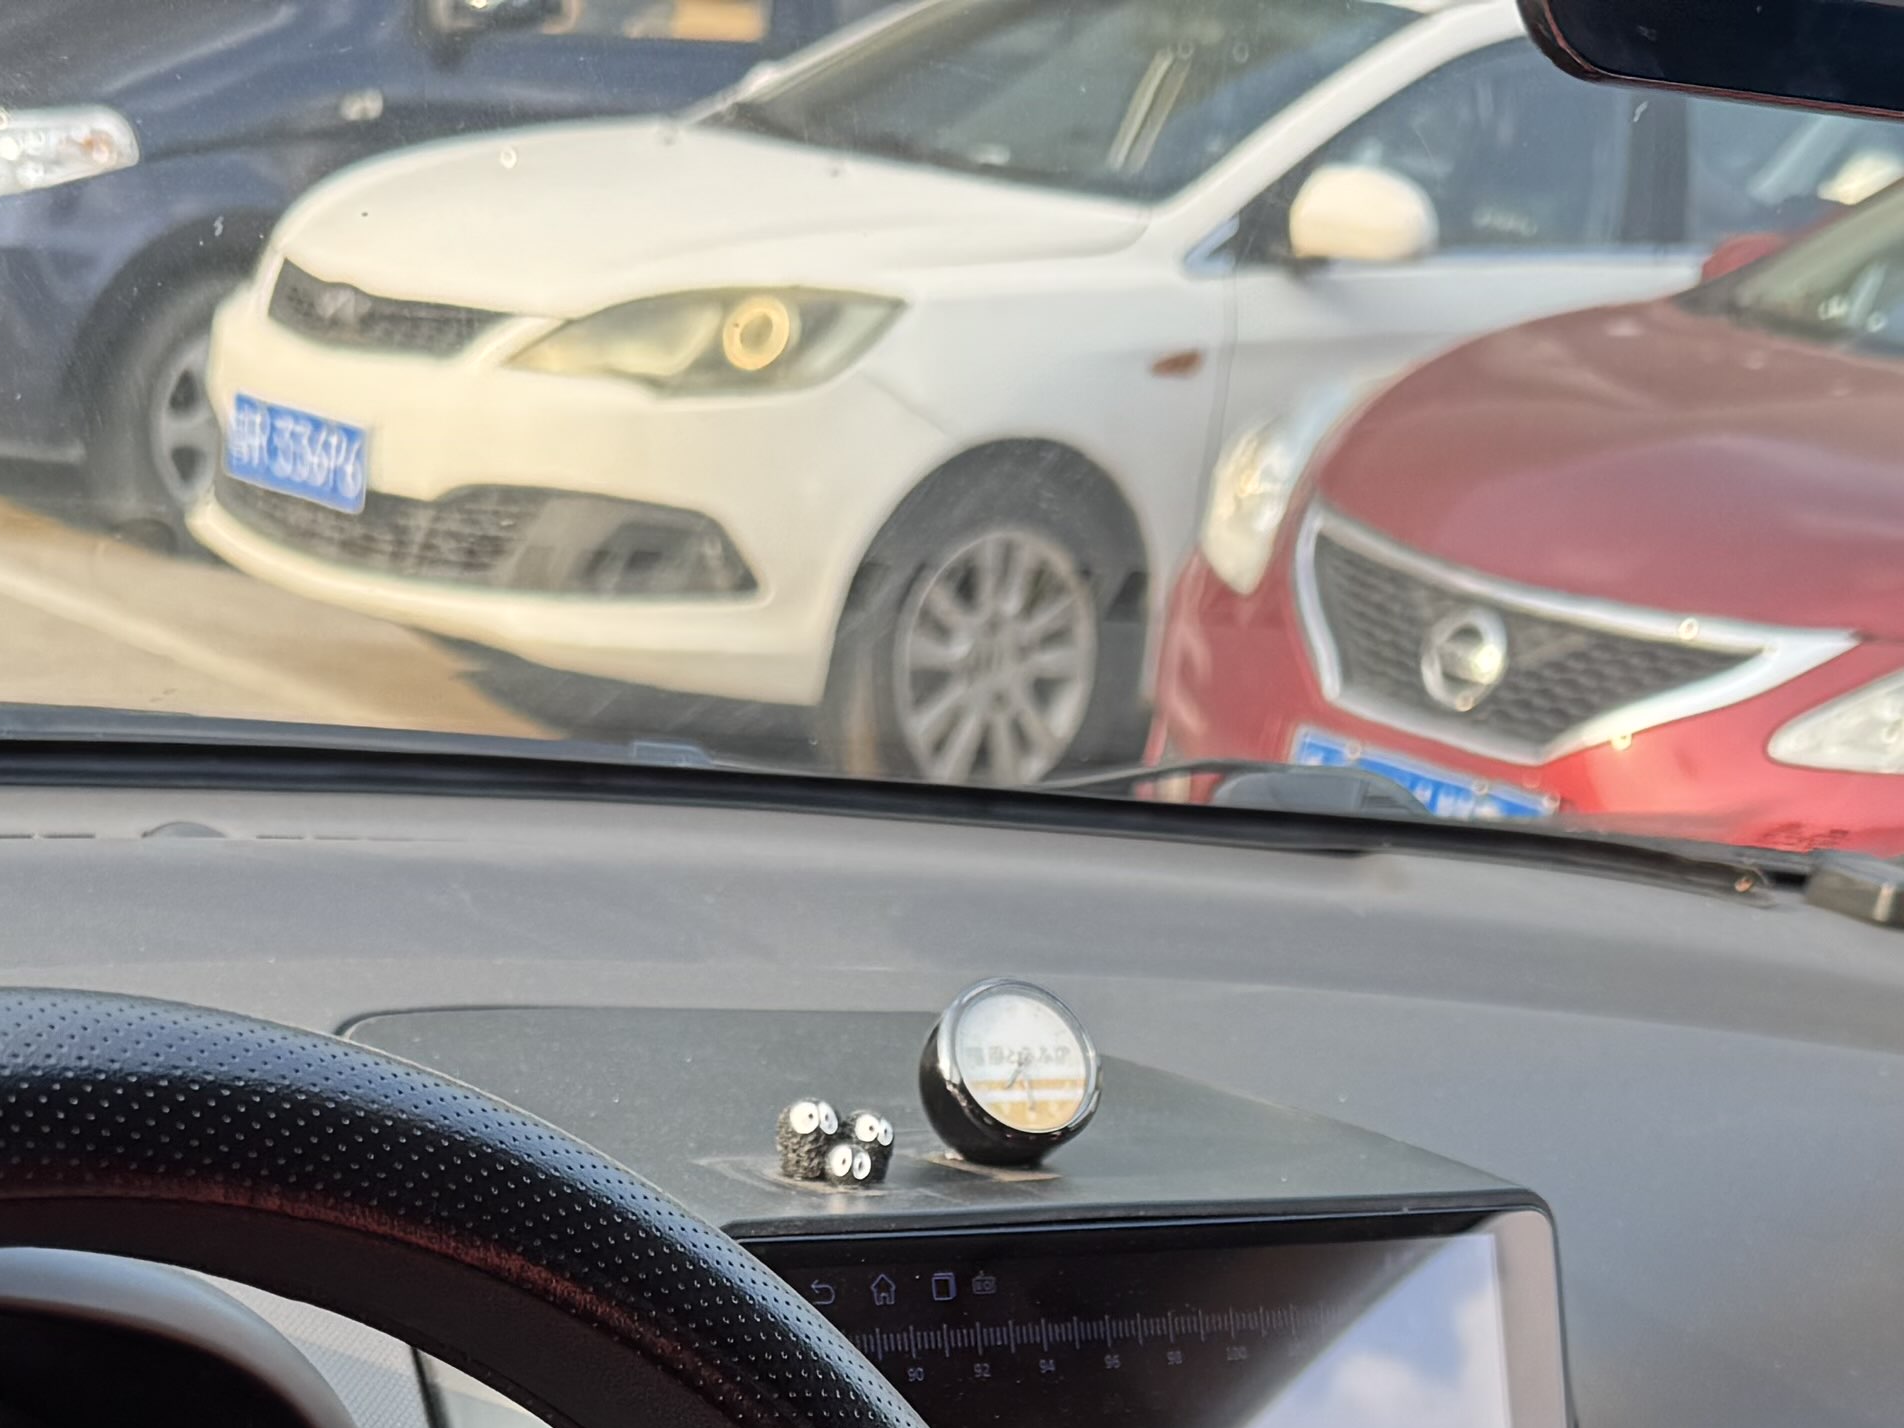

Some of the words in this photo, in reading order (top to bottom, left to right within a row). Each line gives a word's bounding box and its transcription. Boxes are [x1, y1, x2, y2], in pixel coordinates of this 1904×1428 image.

[907, 1367, 925, 1382] 90
[973, 1363, 992, 1378] 92
[1039, 1358, 1056, 1374] 94
